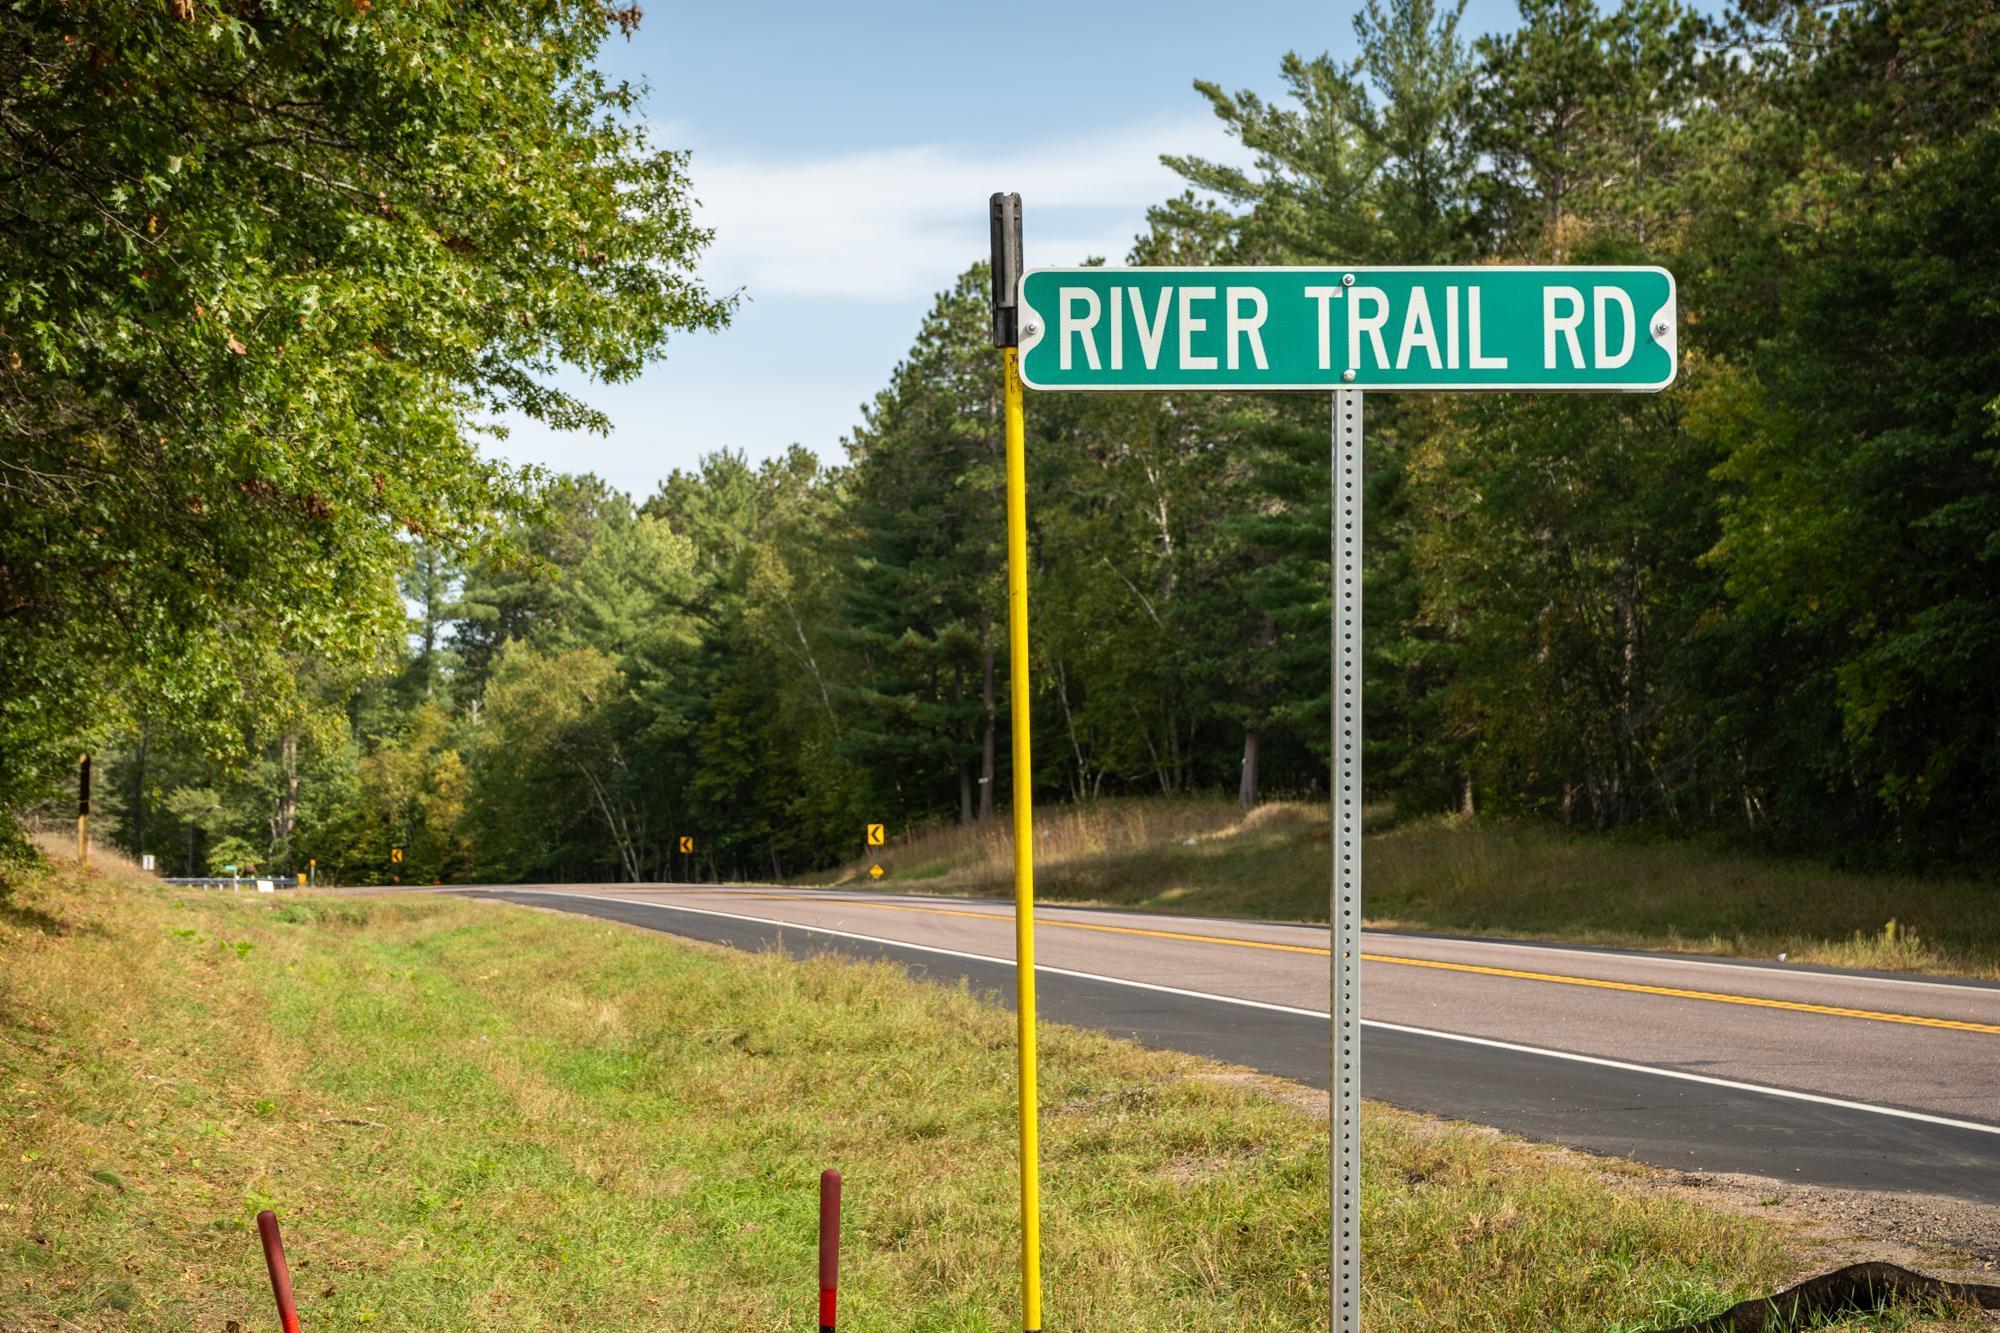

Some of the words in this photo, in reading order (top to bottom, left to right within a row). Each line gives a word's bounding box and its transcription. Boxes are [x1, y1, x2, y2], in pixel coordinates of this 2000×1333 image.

[1059, 286, 1269, 370] RIVER
[1304, 286, 1508, 370] TRAIL
[1543, 286, 1636, 369] RD
